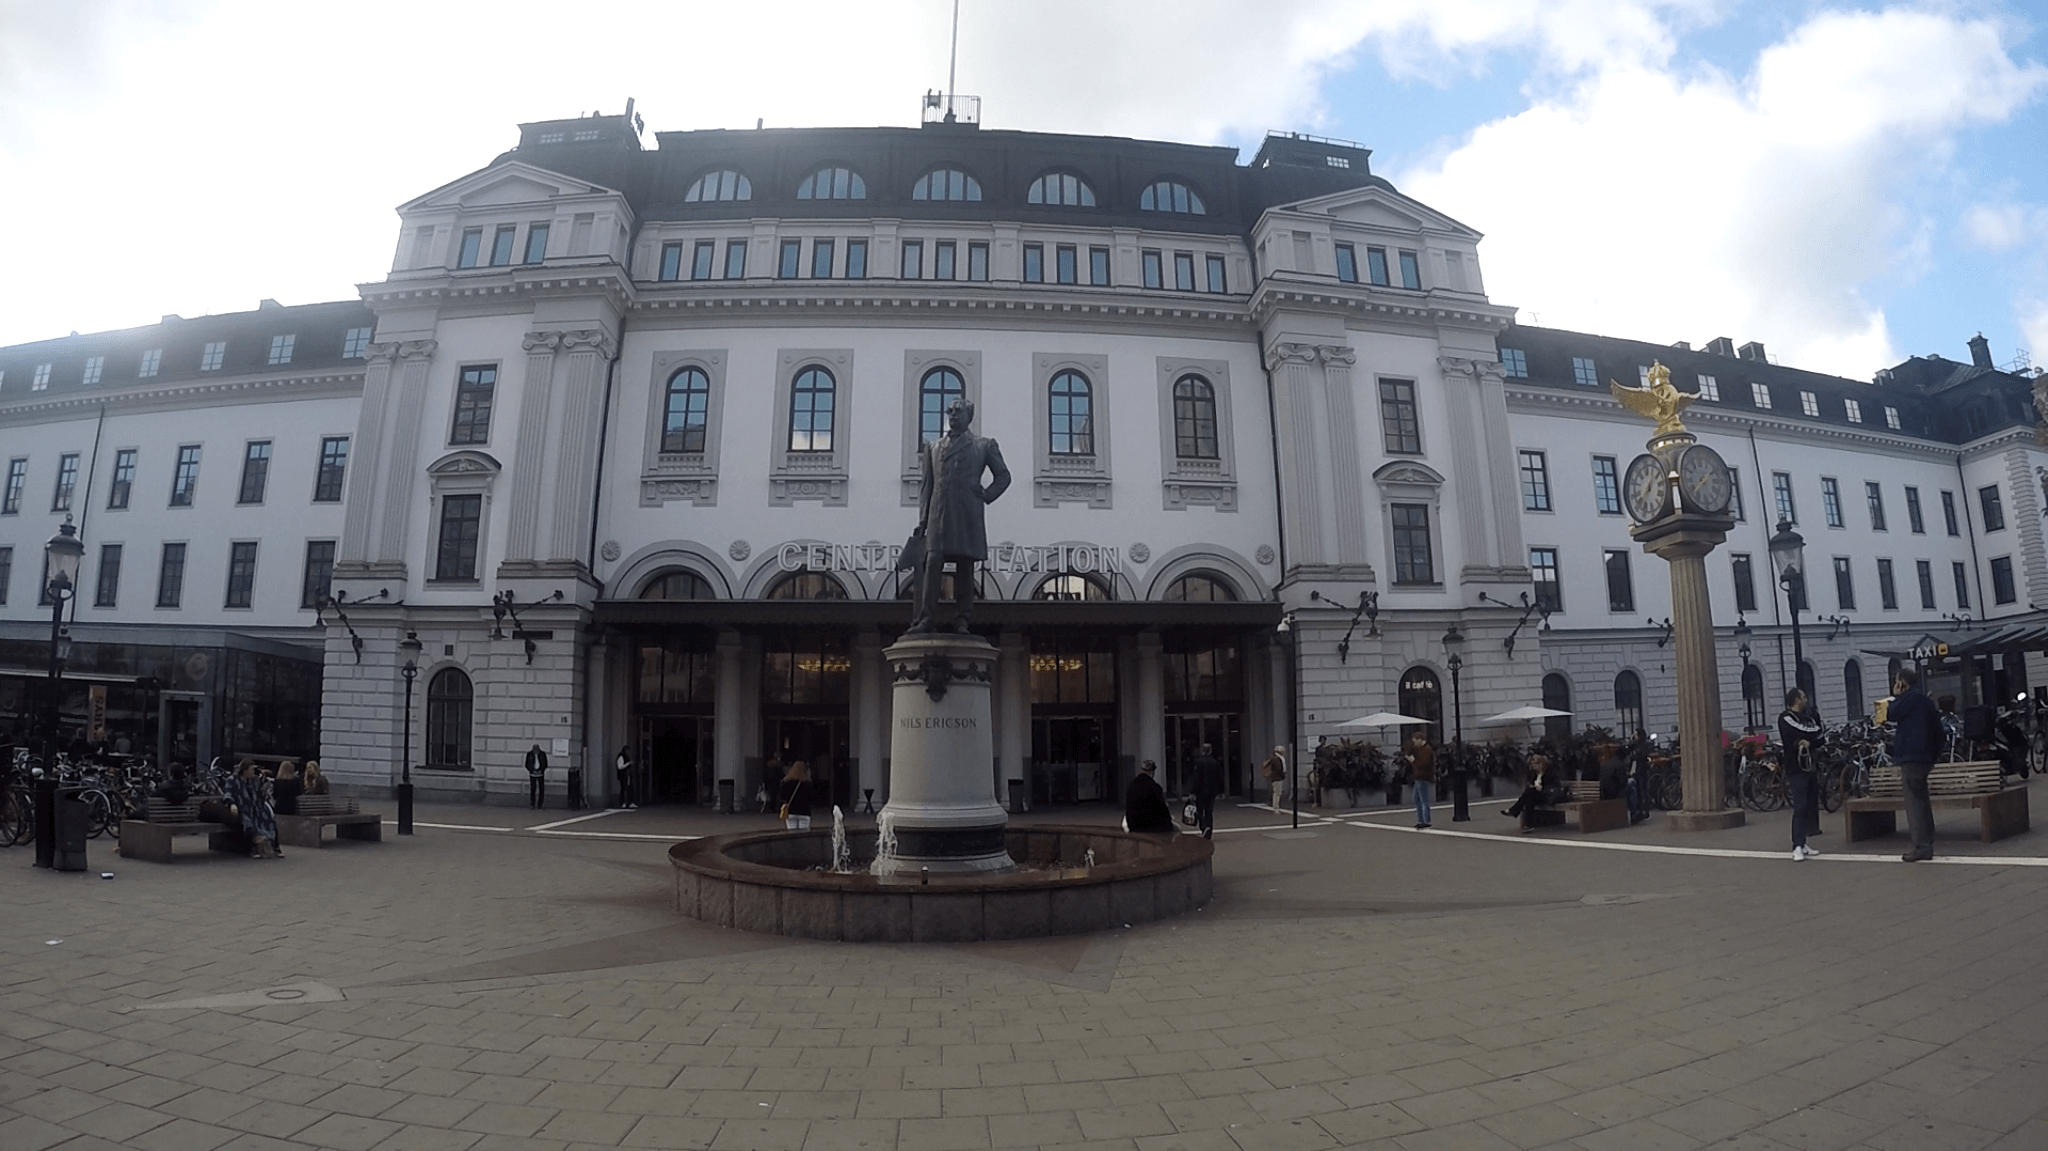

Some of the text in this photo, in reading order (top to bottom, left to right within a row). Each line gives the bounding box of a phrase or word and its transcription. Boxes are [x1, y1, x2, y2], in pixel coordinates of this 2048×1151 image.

[1907, 645, 1937, 659] TAXI
[900, 717, 977, 729] NILS ERICSON
